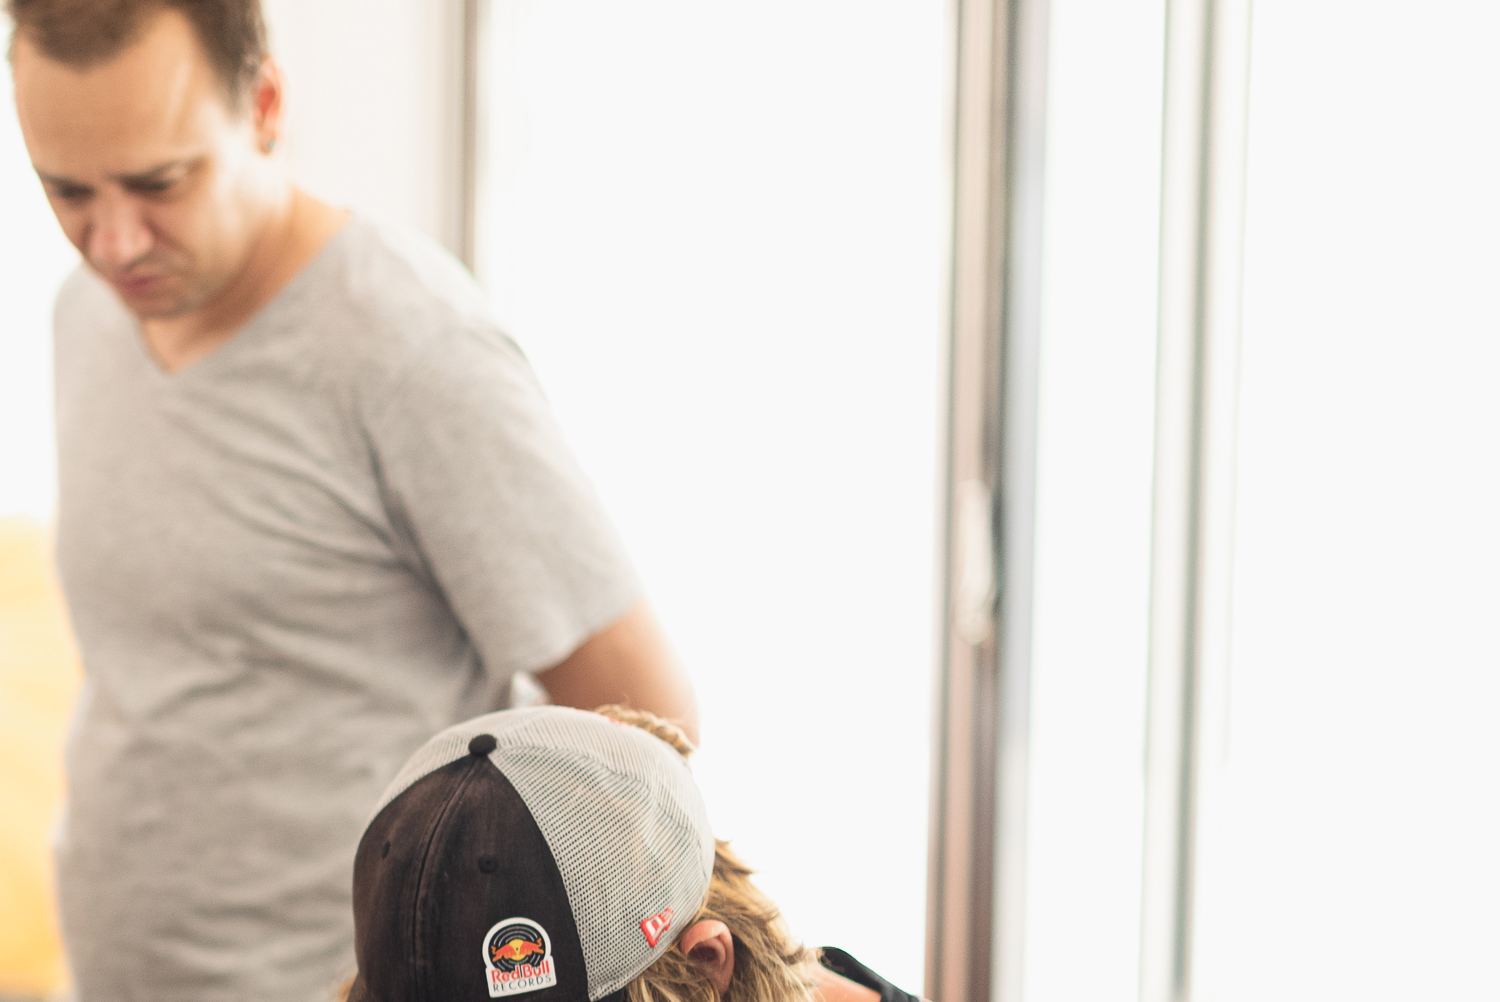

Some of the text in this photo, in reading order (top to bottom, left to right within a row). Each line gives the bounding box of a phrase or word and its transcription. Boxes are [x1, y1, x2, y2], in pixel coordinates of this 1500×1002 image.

[491, 960, 550, 983] Red Bull
[492, 976, 551, 992] RECORDS
